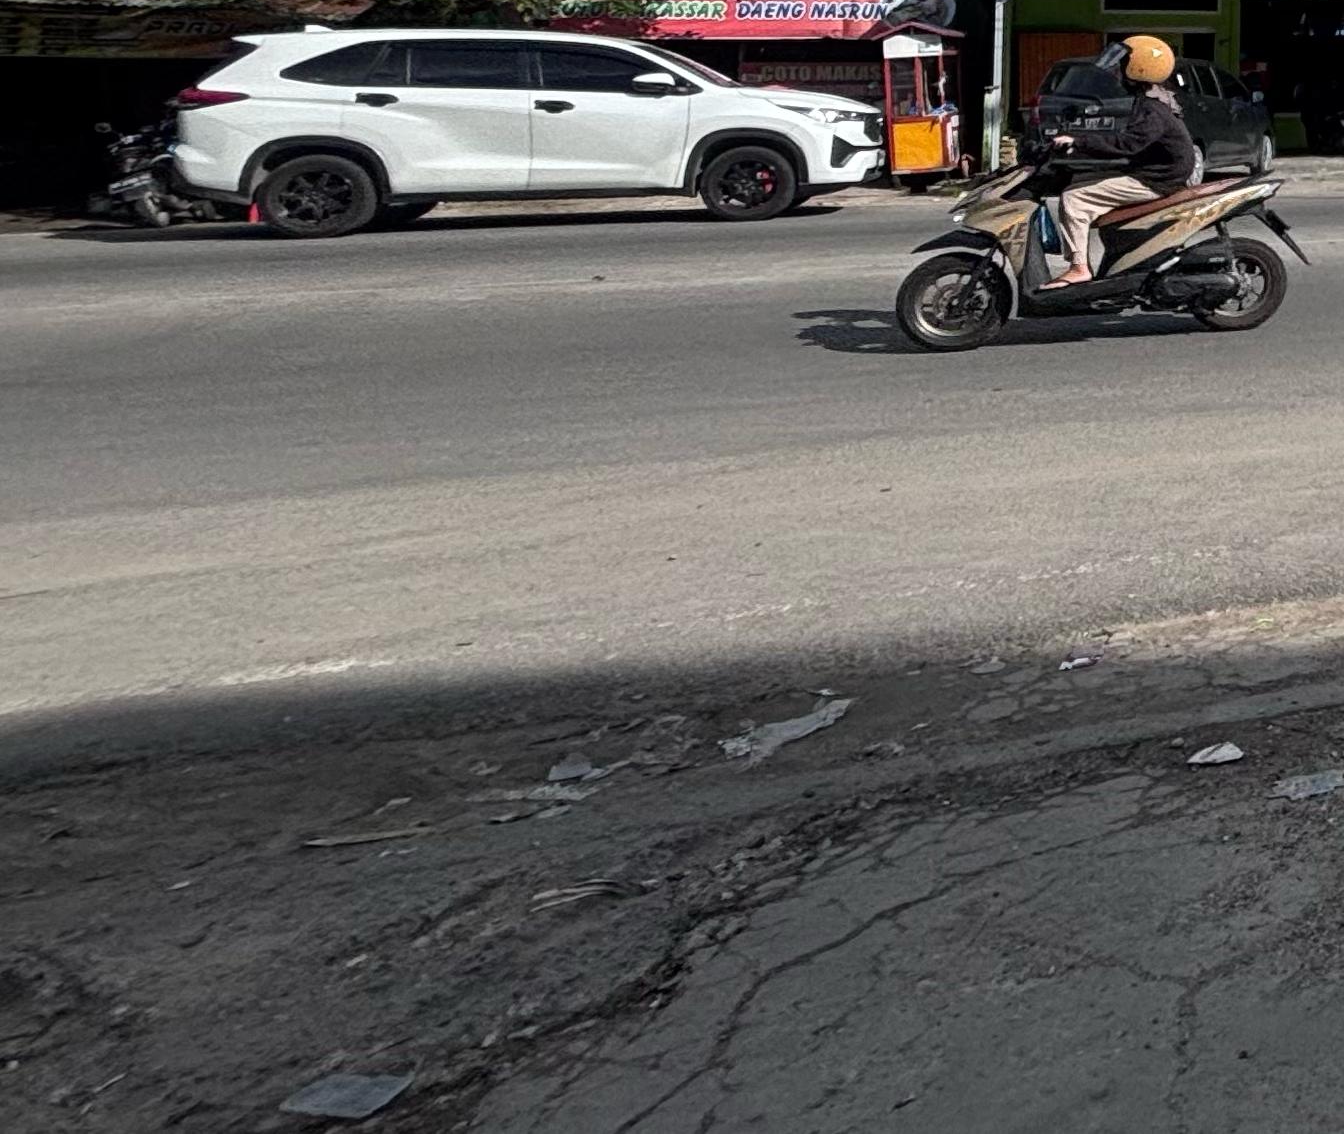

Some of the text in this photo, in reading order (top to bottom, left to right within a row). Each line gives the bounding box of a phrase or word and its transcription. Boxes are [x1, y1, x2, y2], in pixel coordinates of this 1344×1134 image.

[736, 1, 805, 20] DAENG
[810, 2, 889, 21] NASRUN
[760, 65, 812, 82] COTO
